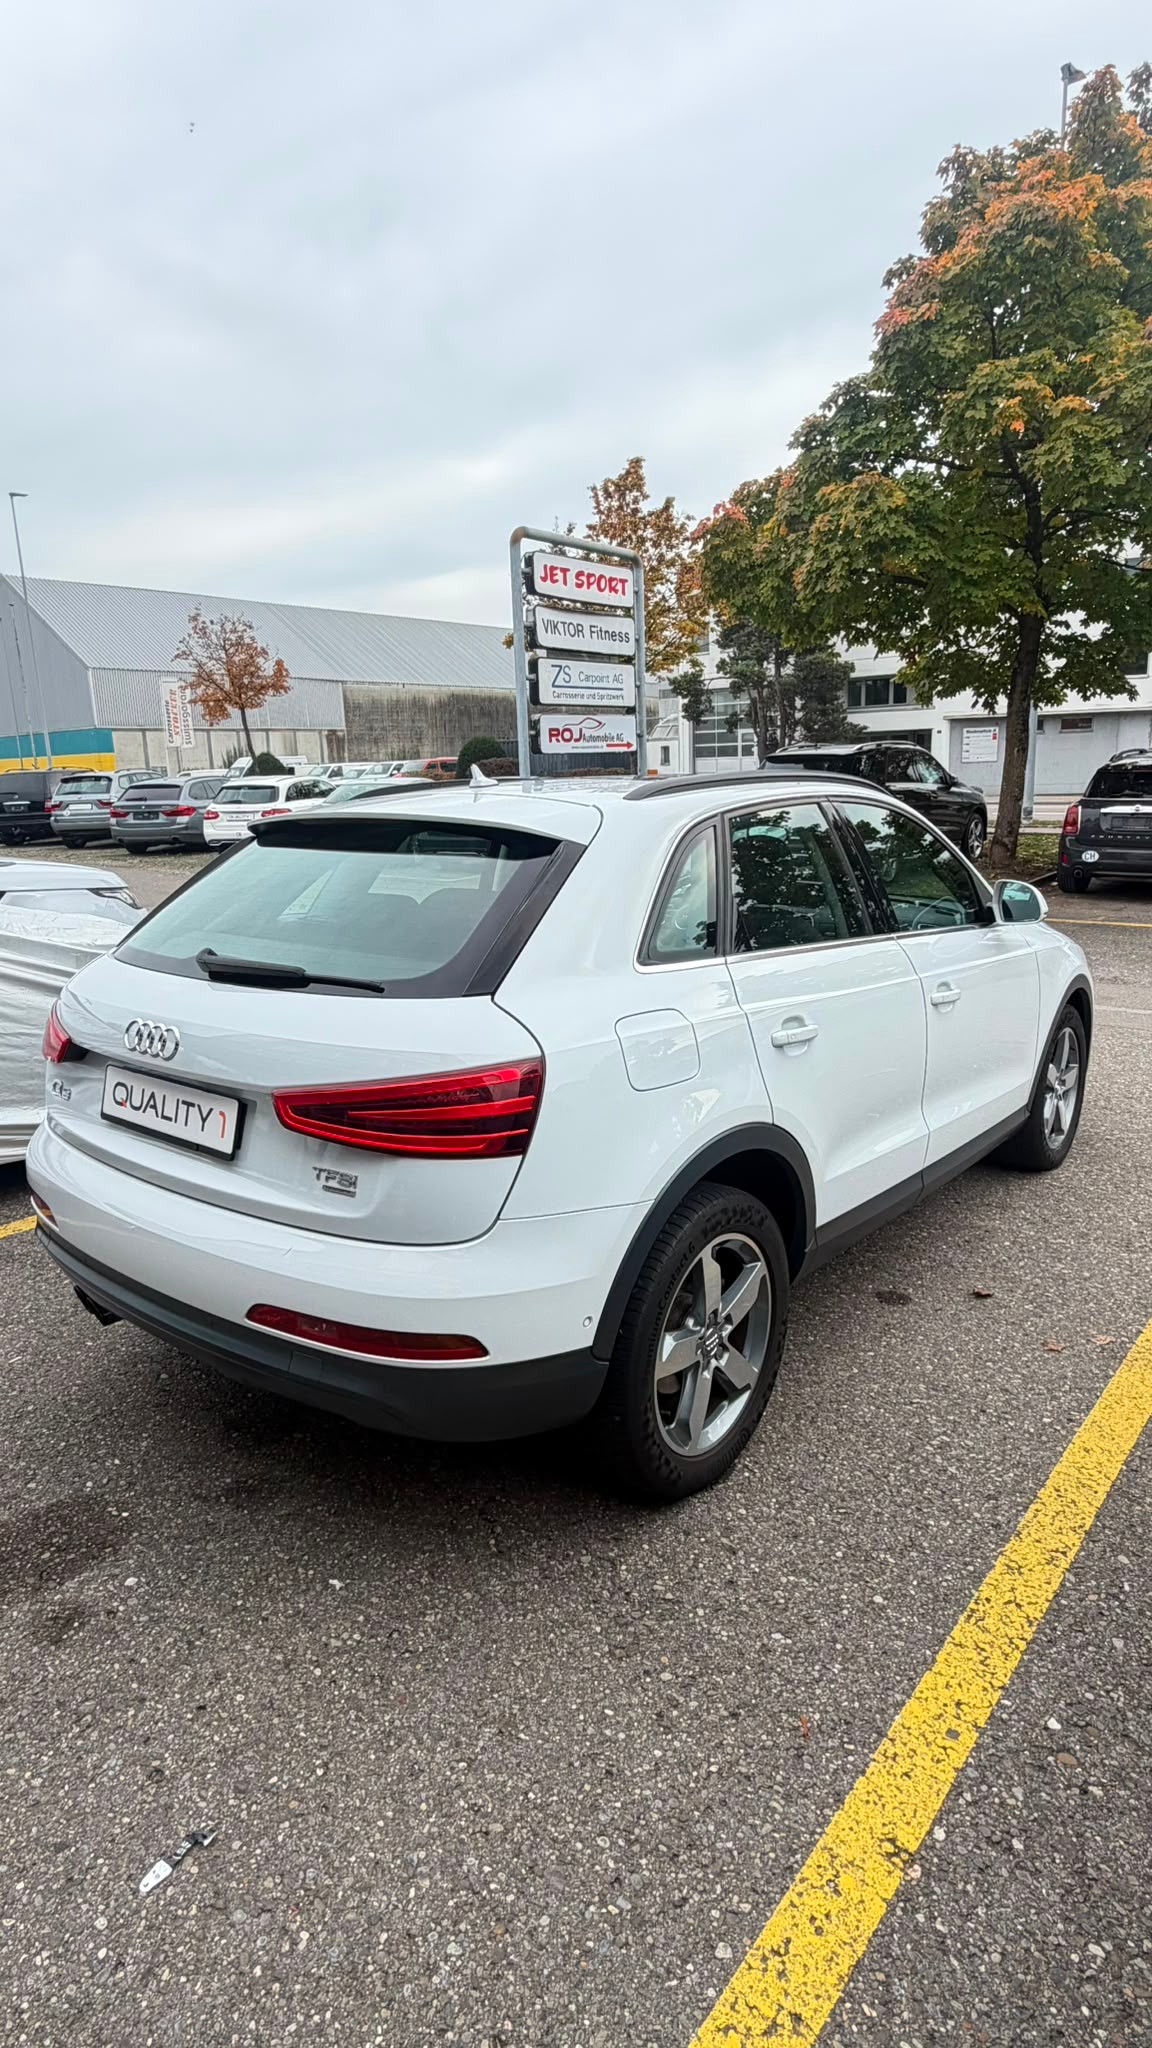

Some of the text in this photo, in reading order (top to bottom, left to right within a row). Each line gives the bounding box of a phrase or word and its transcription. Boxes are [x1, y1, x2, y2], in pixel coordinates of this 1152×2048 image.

[540, 564, 629, 596] JET SPORT
[541, 617, 630, 643] VIKTOR Fitness
[551, 664, 624, 688] ZS Carpoint AG
[552, 690, 585, 699] Carrosserie
[178, 684, 193, 745] swissgaran
[548, 727, 624, 743] ROJ Automobile AG
[1084, 852, 1096, 861] CH
[312, 1166, 359, 1190] TFSI
